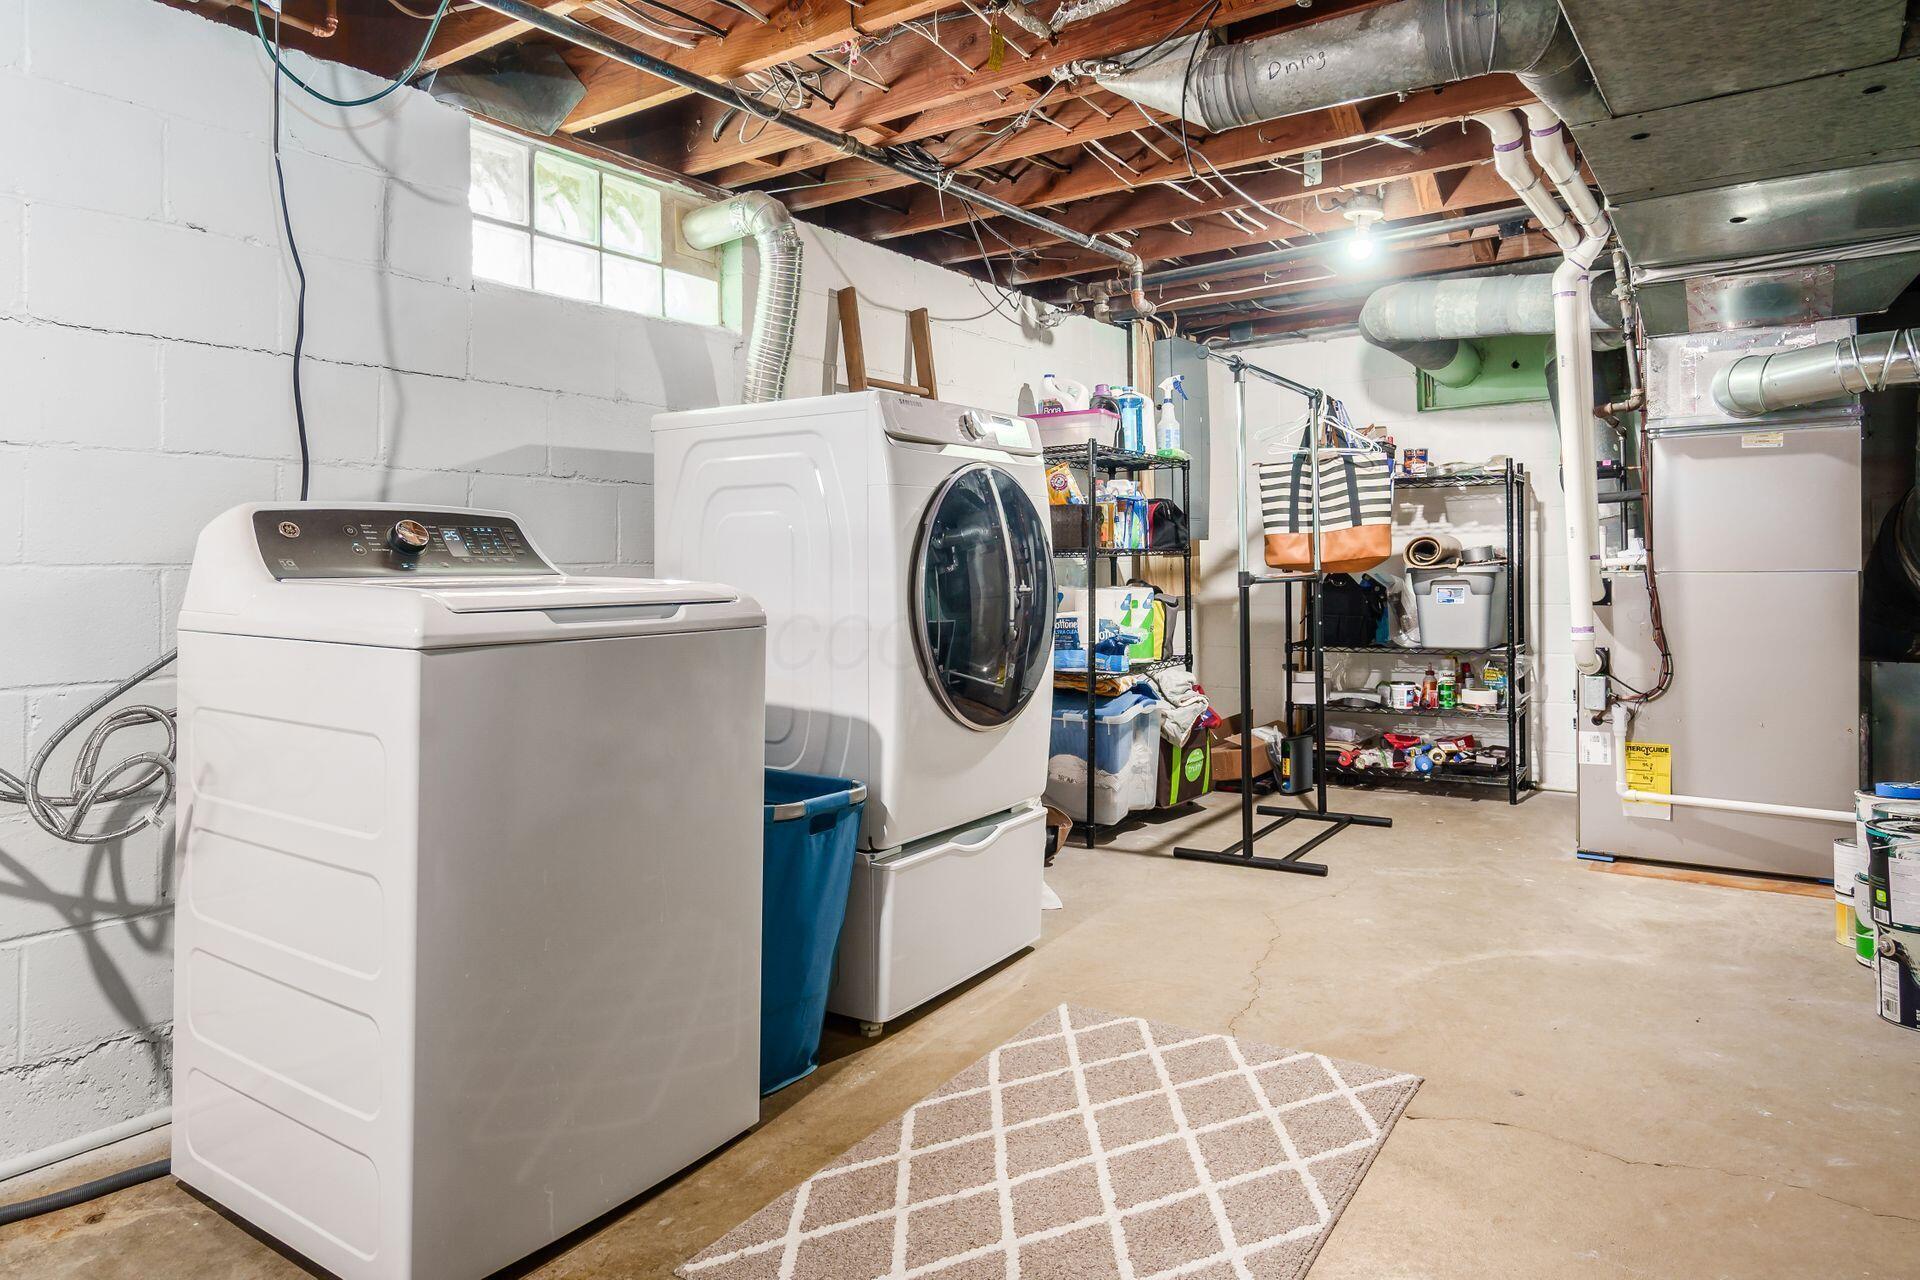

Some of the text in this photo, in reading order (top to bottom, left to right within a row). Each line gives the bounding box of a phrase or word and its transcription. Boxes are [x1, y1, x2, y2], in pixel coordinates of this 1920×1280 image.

[1268, 51, 1326, 80] Dining
[443, 530, 460, 541] 25
[1625, 745, 1670, 754] NERGYGUIDE
